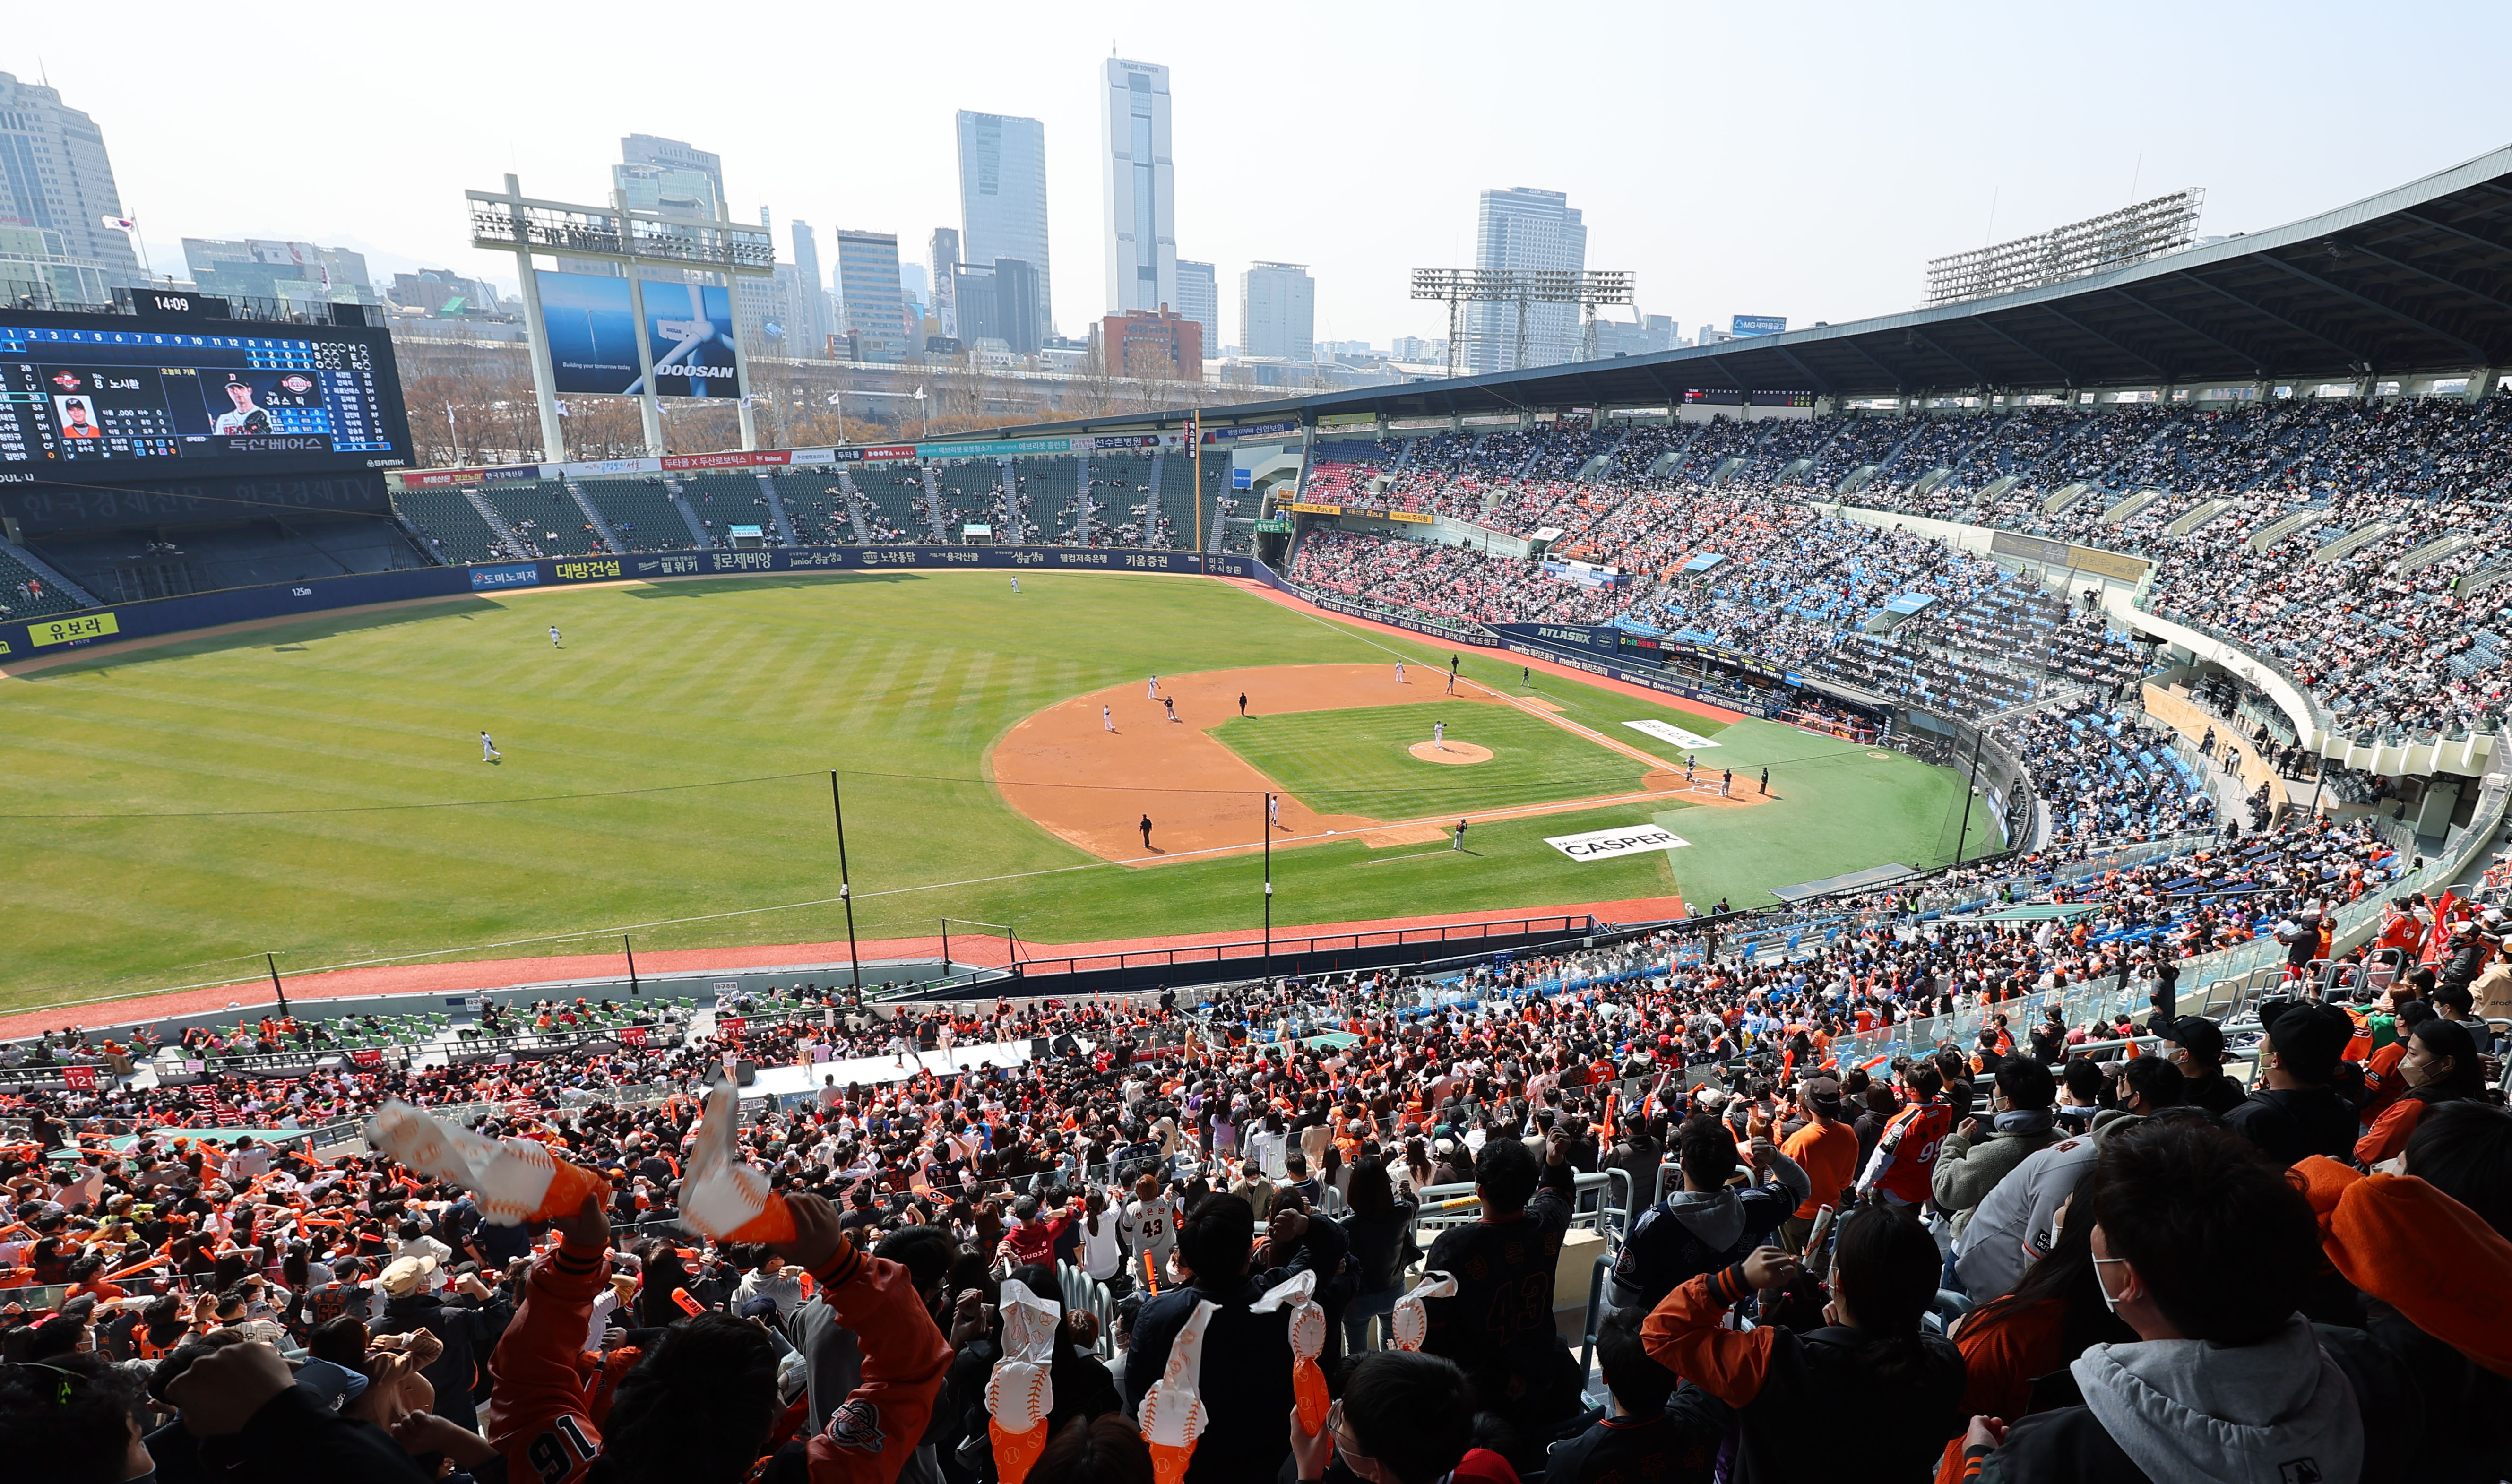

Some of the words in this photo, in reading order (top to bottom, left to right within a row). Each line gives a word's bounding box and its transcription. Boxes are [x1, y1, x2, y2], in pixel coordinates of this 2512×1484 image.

[1120, 62, 1138, 70] TRADE
[1140, 65, 1159, 73] TOWER
[154, 296, 189, 311] 14:09
[8, 330, 14, 338] 1
[28, 331, 36, 339] 2
[51, 331, 59, 340] 3
[73, 332, 81, 341] 4
[94, 333, 102, 341] 5
[115, 334, 122, 342] 6
[135, 335, 142, 343] 7
[155, 336, 163, 344] 8
[174, 336, 181, 344] 9
[191, 337, 202, 345] 10
[10, 342, 17, 351] 1
[285, 351, 292, 359] 0
[312, 342, 319, 350] B
[348, 344, 356, 352] H
[253, 360, 260, 368] 0
[270, 361, 277, 369] 0
[287, 361, 294, 369] 0
[303, 361, 310, 369] 0
[563, 362, 582, 370] Building
[657, 364, 734, 379] DOOSAN
[95, 379, 104, 389] 8
[109, 379, 140, 389] 노시환
[266, 396, 280, 406] 34
[37, 423, 50, 431] DH
[1255, 423, 1285, 434] 신협보험
[2, 442, 26, 451] 이원석
[963, 444, 992, 452] 로봇청소기
[1095, 437, 1142, 448] 선수촌병원
[4, 452, 28, 461] 김민우
[837, 450, 859, 459] 두타몰
[627, 459, 643, 471] 서울
[665, 459, 690, 468] 두타몰
[700, 454, 747, 466] 두산로보틱스
[423, 475, 451, 483] 부동산은
[485, 470, 523, 479] 한국경제신문
[1411, 514, 1429, 522] 주식창
[1257, 523, 1280, 532] 올원뱅크
[721, 552, 772, 569] 로제비앙
[790, 557, 812, 567] junior
[810, 552, 842, 565] 생글생글
[880, 552, 916, 563] 노랑통닭
[946, 552, 979, 561] 용각산쿨
[1011, 551, 1044, 564] 생글생글
[1060, 553, 1107, 564] 웰컴저축은행
[1125, 554, 1168, 568] 키움증권
[1209, 557, 1225, 565] 미국
[556, 560, 622, 579] 대방건설
[661, 561, 699, 573] 밀워키
[1209, 565, 1233, 573] 주식창
[484, 570, 537, 584] 도미노피자
[292, 587, 312, 597] 125m
[1323, 600, 1341, 612] 백조씽크
[1363, 611, 1382, 621] 백조씽크
[49, 618, 101, 641] 유보라
[1421, 624, 1442, 636] 백조씽크
[1468, 634, 1498, 647] 백조씽크
[1537, 627, 1592, 645] ATLASBX
[1509, 643, 1530, 656] meritz
[1530, 648, 1555, 663] 메리츠증권
[1558, 657, 1581, 669] meritz
[1581, 662, 1608, 677] 메리츠화재
[1621, 673, 1631, 681] QV
[1658, 683, 1685, 696] NH투자증권
[1703, 694, 1717, 705] 금강주택
[1750, 706, 1765, 717] 금강주택
[1565, 832, 1680, 855] CASPER
[1571, 836, 1607, 844] HYUNDAI
[1528, 977, 1540, 985] 115
[622, 1035, 646, 1045] 119
[1655, 1062, 1671, 1074] 52
[68, 1076, 95, 1087] 121
[1597, 1075, 1606, 1083] 7
[936, 1176, 947, 1191] 7
[1135, 1207, 1165, 1219] 정은원
[1142, 1219, 1163, 1238] 43
[1466, 1232, 1558, 1281] 정은원
[682, 1294, 701, 1313] Eag
[1487, 1271, 1549, 1345] 43
[527, 1415, 598, 1484] 91
